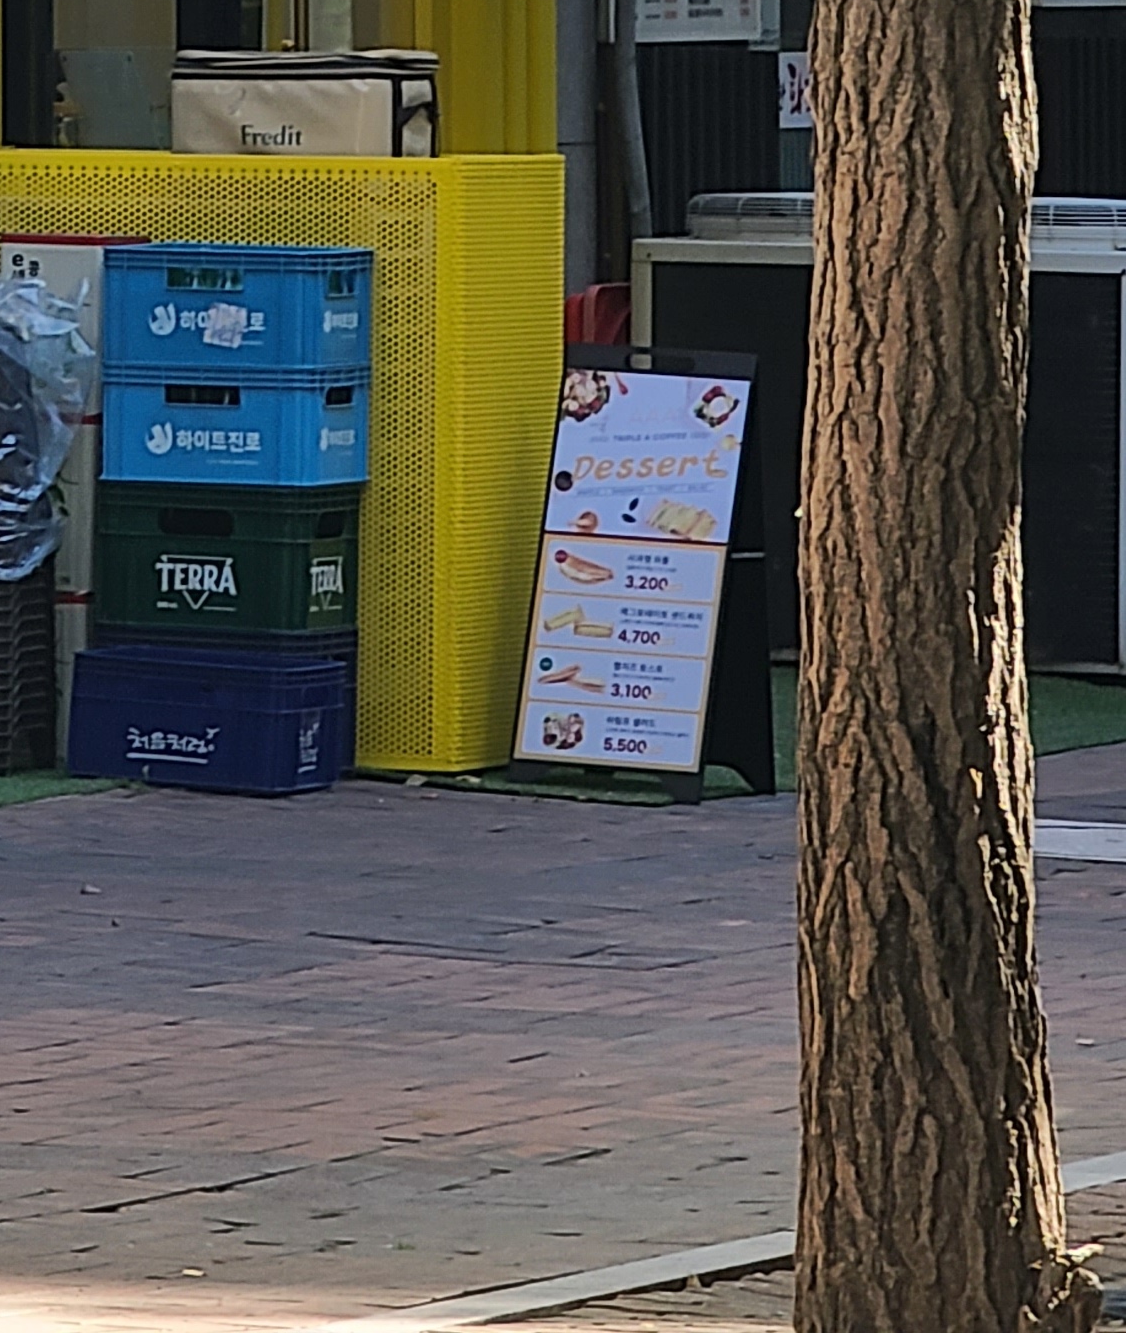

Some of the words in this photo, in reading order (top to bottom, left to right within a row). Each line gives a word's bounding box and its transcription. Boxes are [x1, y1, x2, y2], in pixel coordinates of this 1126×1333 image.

[241, 123, 303, 146] Fredit
[176, 429, 262, 453] 하이트진로
[573, 449, 729, 482] Dessert
[155, 562, 238, 596] TERRA
[310, 564, 344, 596] TERRA
